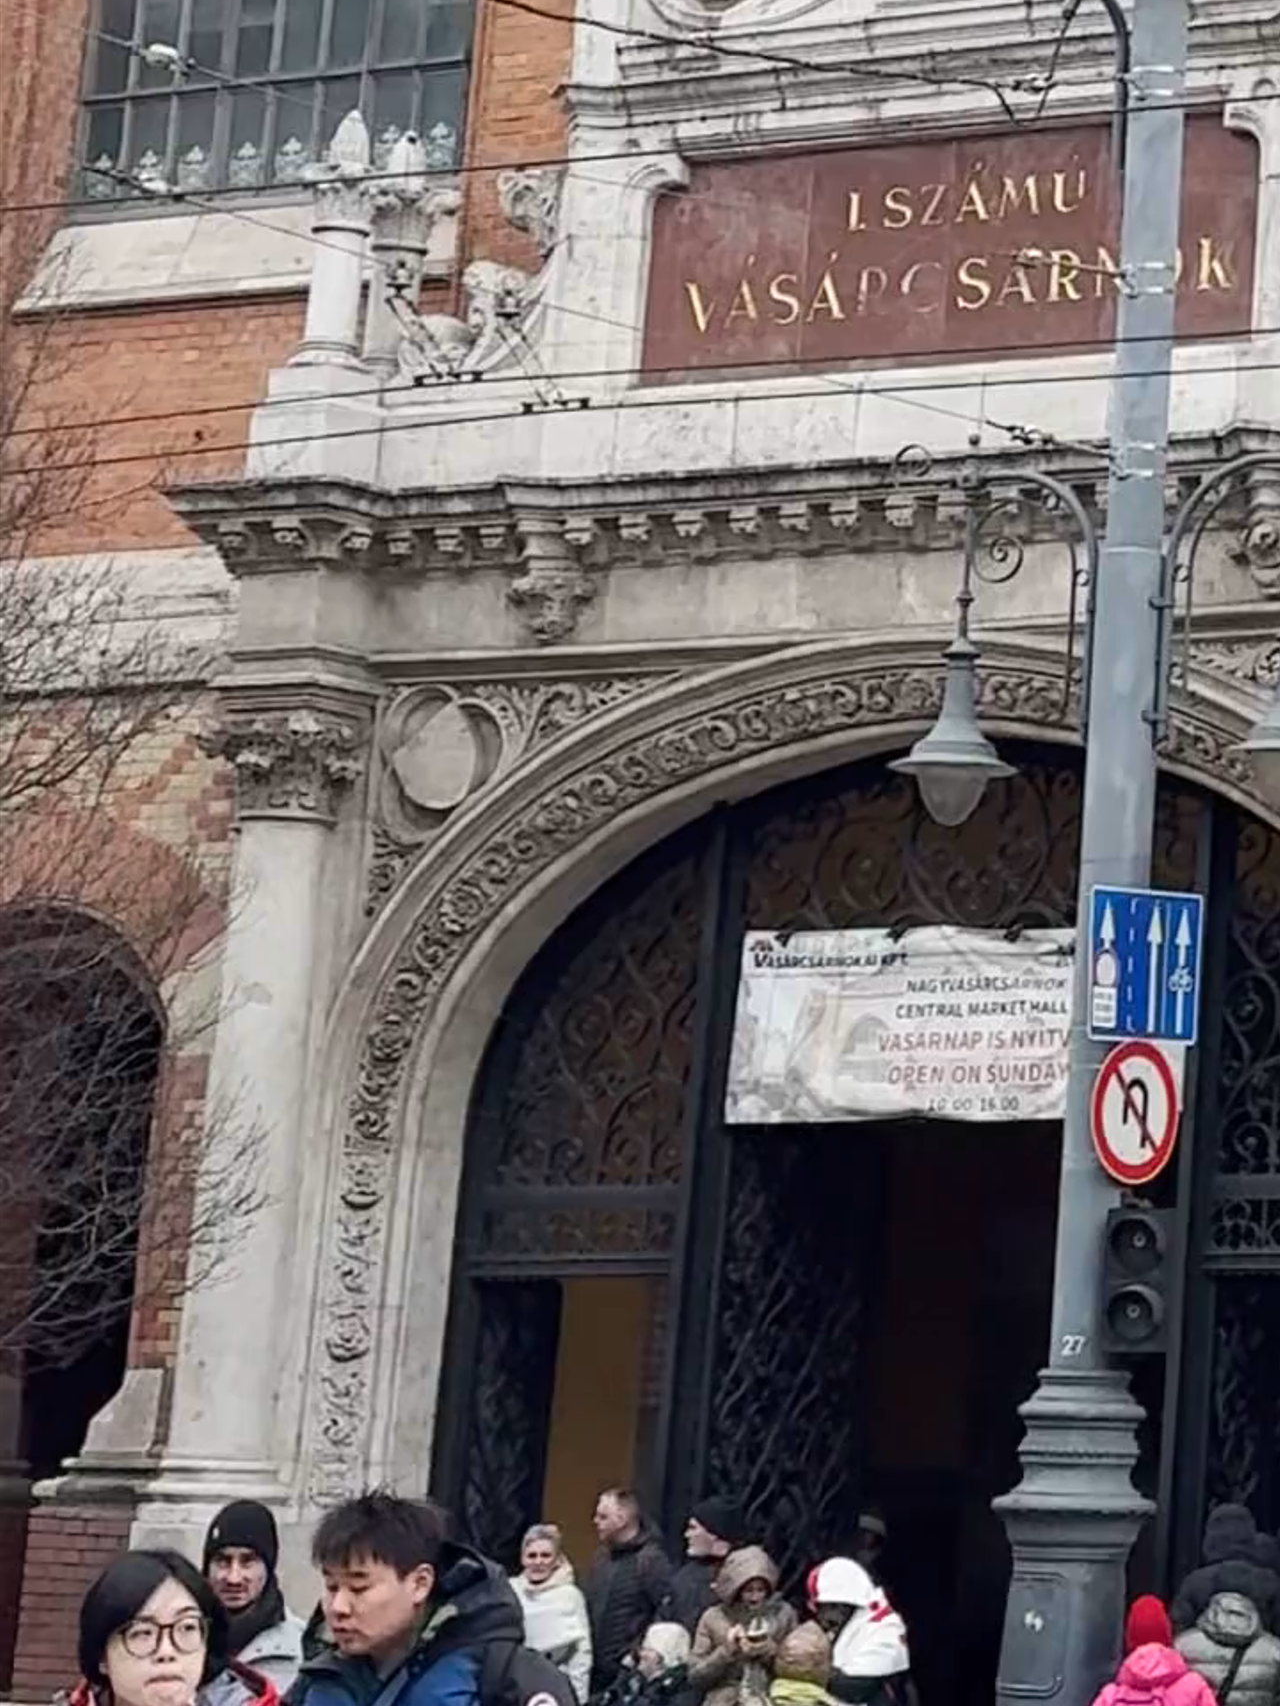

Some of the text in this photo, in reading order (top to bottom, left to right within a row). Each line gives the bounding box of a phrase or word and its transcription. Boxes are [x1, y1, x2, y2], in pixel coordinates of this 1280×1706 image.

[684, 234, 1233, 333] VÁSÁRCSARNK
[896, 1000, 1067, 1019] CENTRAL MARKET HALL
[1011, 1029, 1072, 1049] NYITV
[888, 1065, 945, 1084] OPEN
[951, 1065, 981, 1084] ON
[1062, 1335, 1085, 1356] 27
